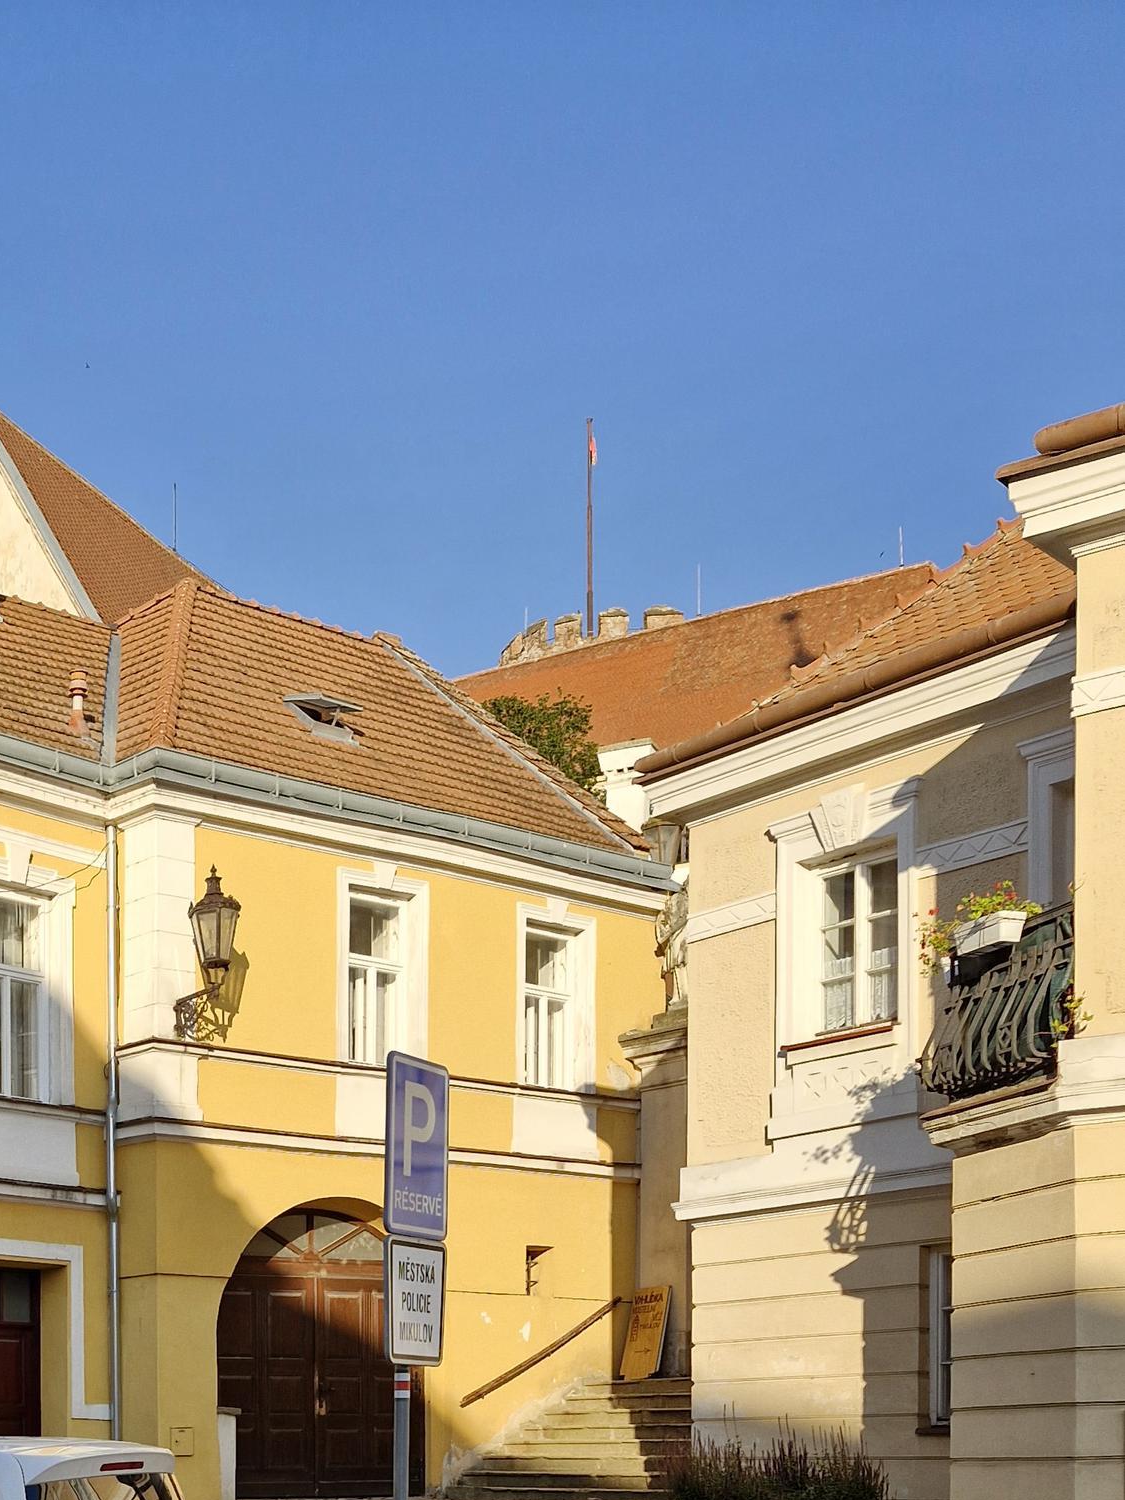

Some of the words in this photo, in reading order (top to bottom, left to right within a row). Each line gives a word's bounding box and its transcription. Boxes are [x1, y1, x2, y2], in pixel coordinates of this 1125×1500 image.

[402, 1080, 436, 1177] P
[394, 1186, 443, 1217] RÉSERVÉ
[398, 1256, 436, 1285] MĚSTSKÁ
[401, 1291, 432, 1316] POLICIE
[399, 1321, 433, 1344] MIKULOV
